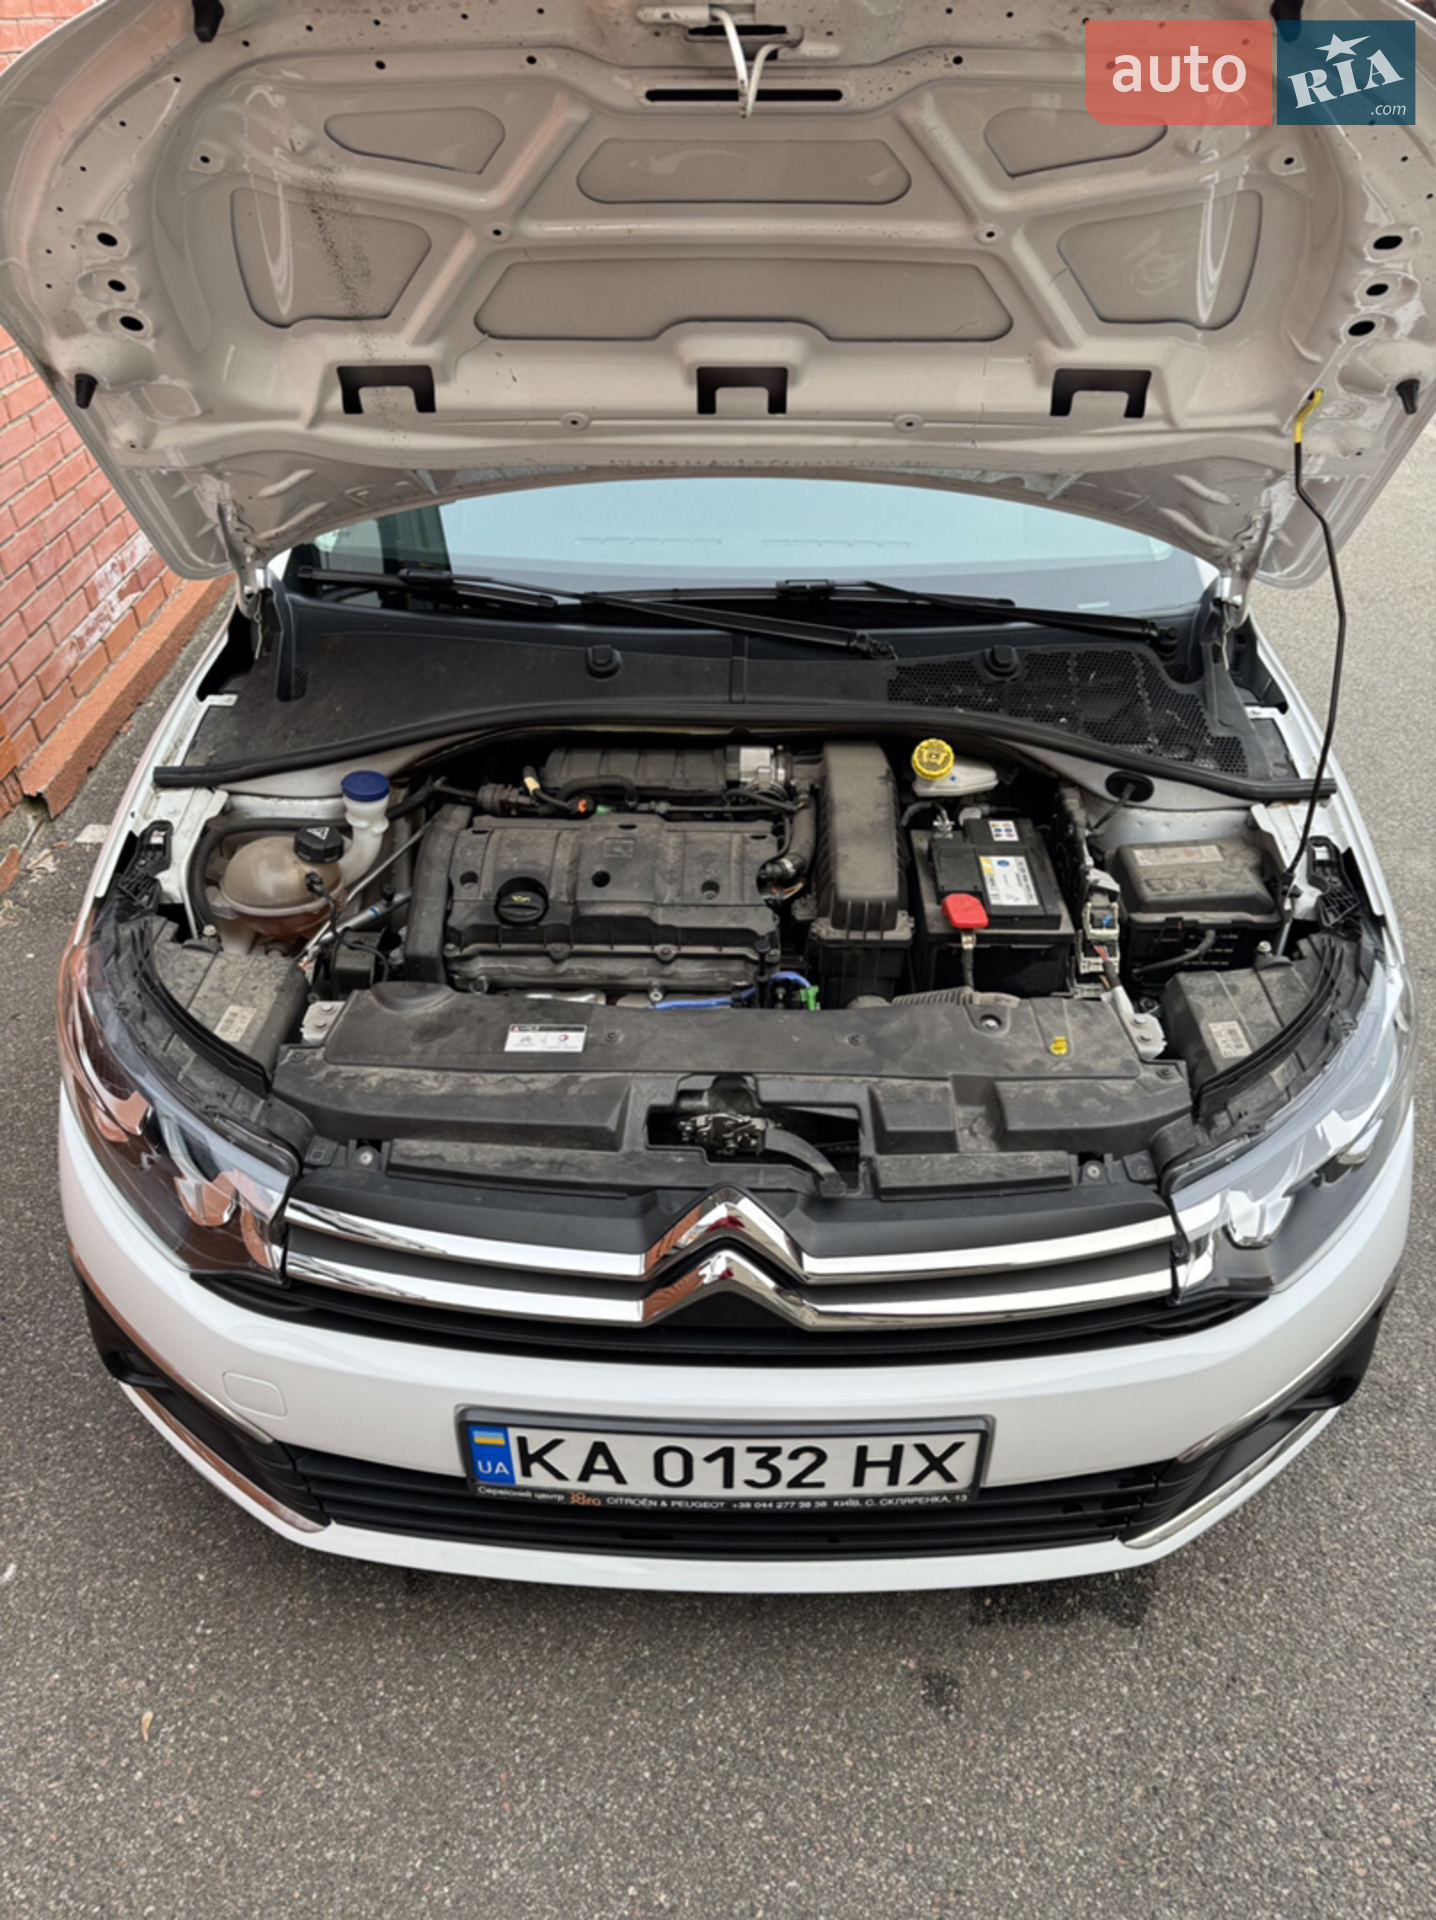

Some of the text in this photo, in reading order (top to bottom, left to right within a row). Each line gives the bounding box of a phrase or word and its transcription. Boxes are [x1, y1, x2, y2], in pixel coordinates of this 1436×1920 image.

[477, 1460, 510, 1476] UA
[516, 1434, 966, 1489] KA 0132 HX
[671, 1501, 725, 1509] PEUGEOT
